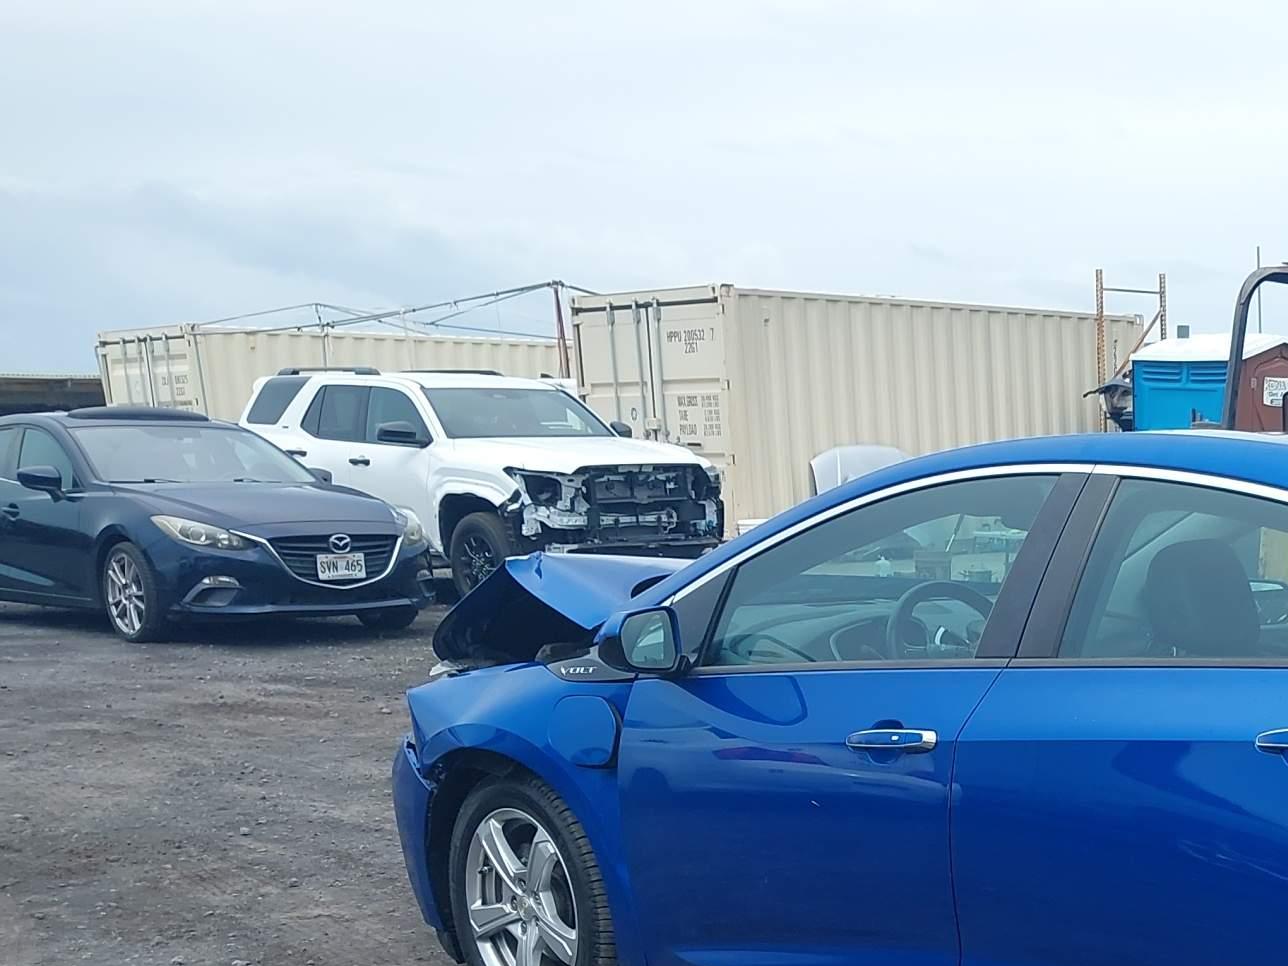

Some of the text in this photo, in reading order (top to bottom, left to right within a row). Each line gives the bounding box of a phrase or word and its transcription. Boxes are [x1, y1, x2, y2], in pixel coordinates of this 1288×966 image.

[320, 559, 363, 574] SVN 465
[560, 666, 597, 676] VOLT
